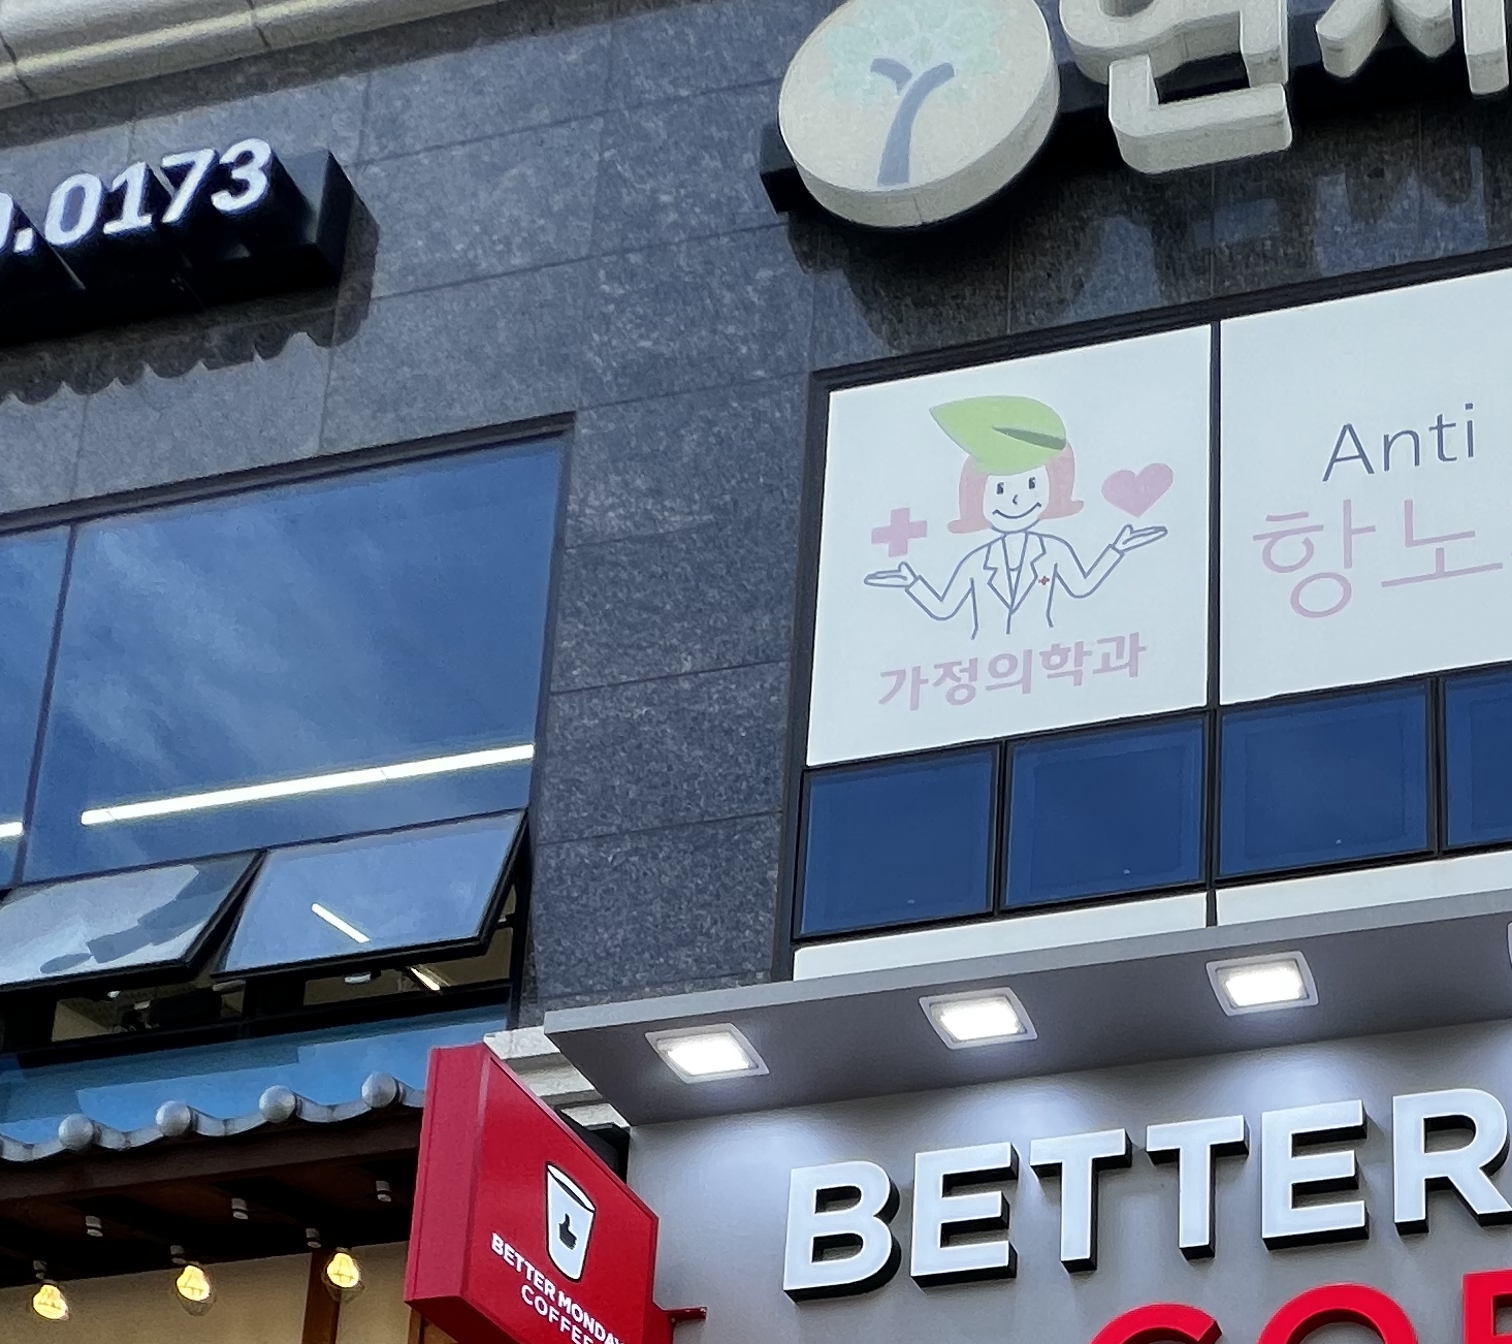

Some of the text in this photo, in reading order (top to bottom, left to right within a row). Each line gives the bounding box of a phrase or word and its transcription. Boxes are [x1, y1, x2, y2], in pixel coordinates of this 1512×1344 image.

[0, 137, 273, 256] .0173
[1321, 402, 1475, 484] Anti
[877, 629, 1149, 711] 가정의학과
[491, 1231, 556, 1302] BETTER
